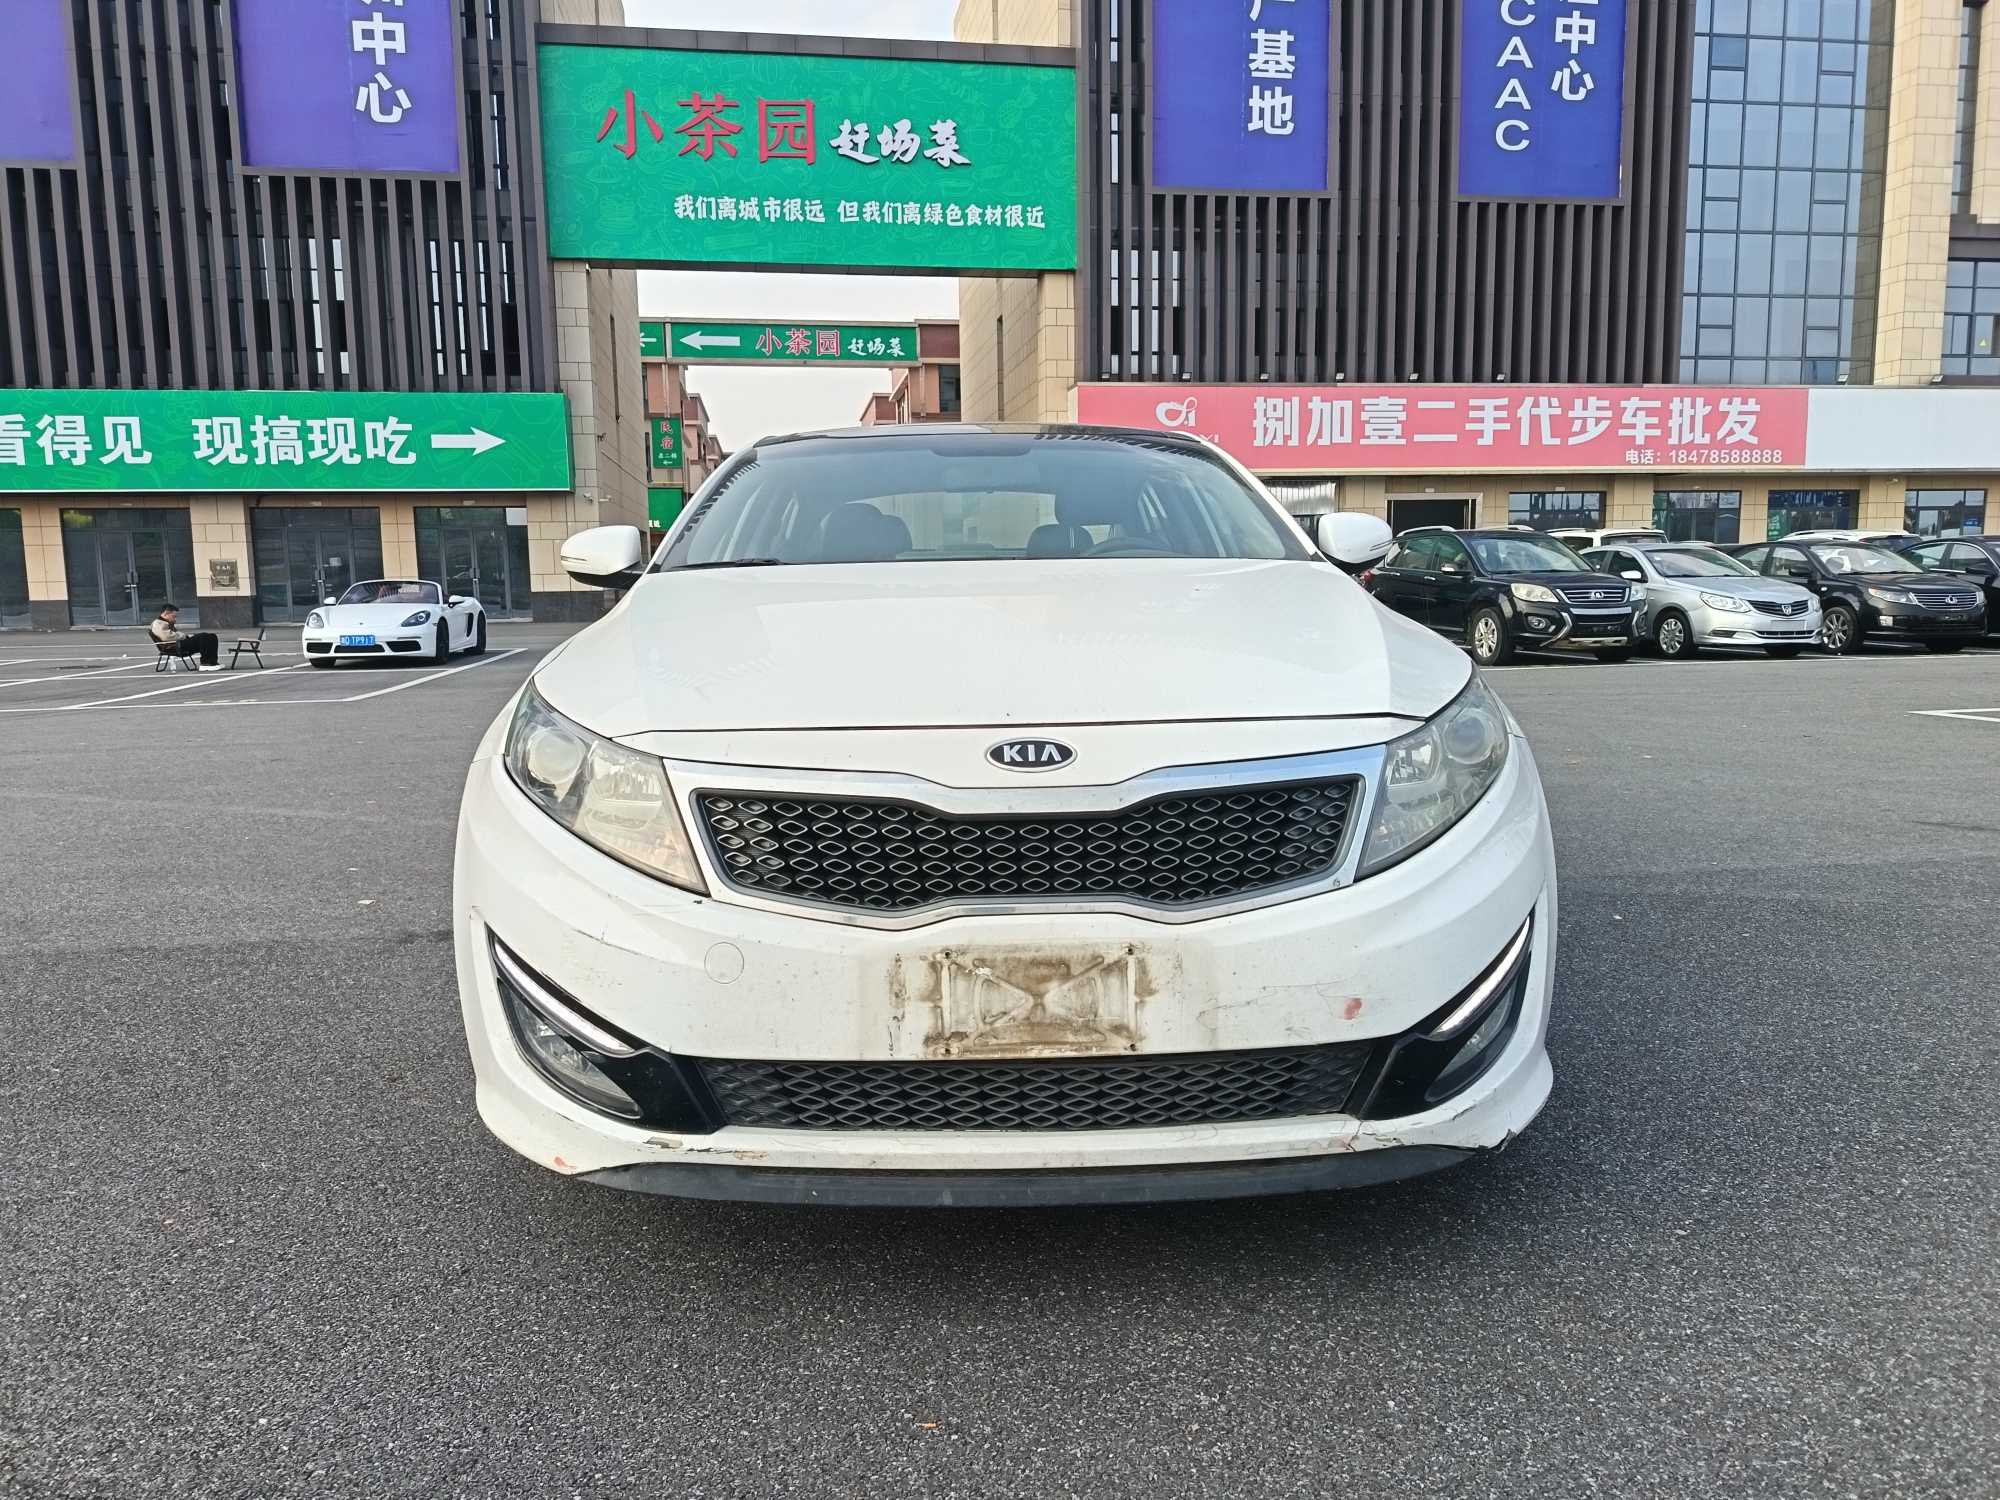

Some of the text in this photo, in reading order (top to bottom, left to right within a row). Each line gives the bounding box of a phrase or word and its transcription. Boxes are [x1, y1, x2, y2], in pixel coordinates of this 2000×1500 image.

[352, 0, 411, 122] 中心
[1552, 0, 1598, 100] 中心
[597, 88, 971, 167] 小茶园 赶场菜
[675, 195, 1044, 227] 我们离城市很远 但我们离绿色食材很近
[757, 328, 904, 357] 小茶园 赶场菜
[192, 416, 416, 464] 现搞现吃
[1253, 396, 1760, 446] 捌加壹二手代步车批发
[1669, 449, 1782, 463] 18478588888
[1003, 745, 1062, 762] KIA
